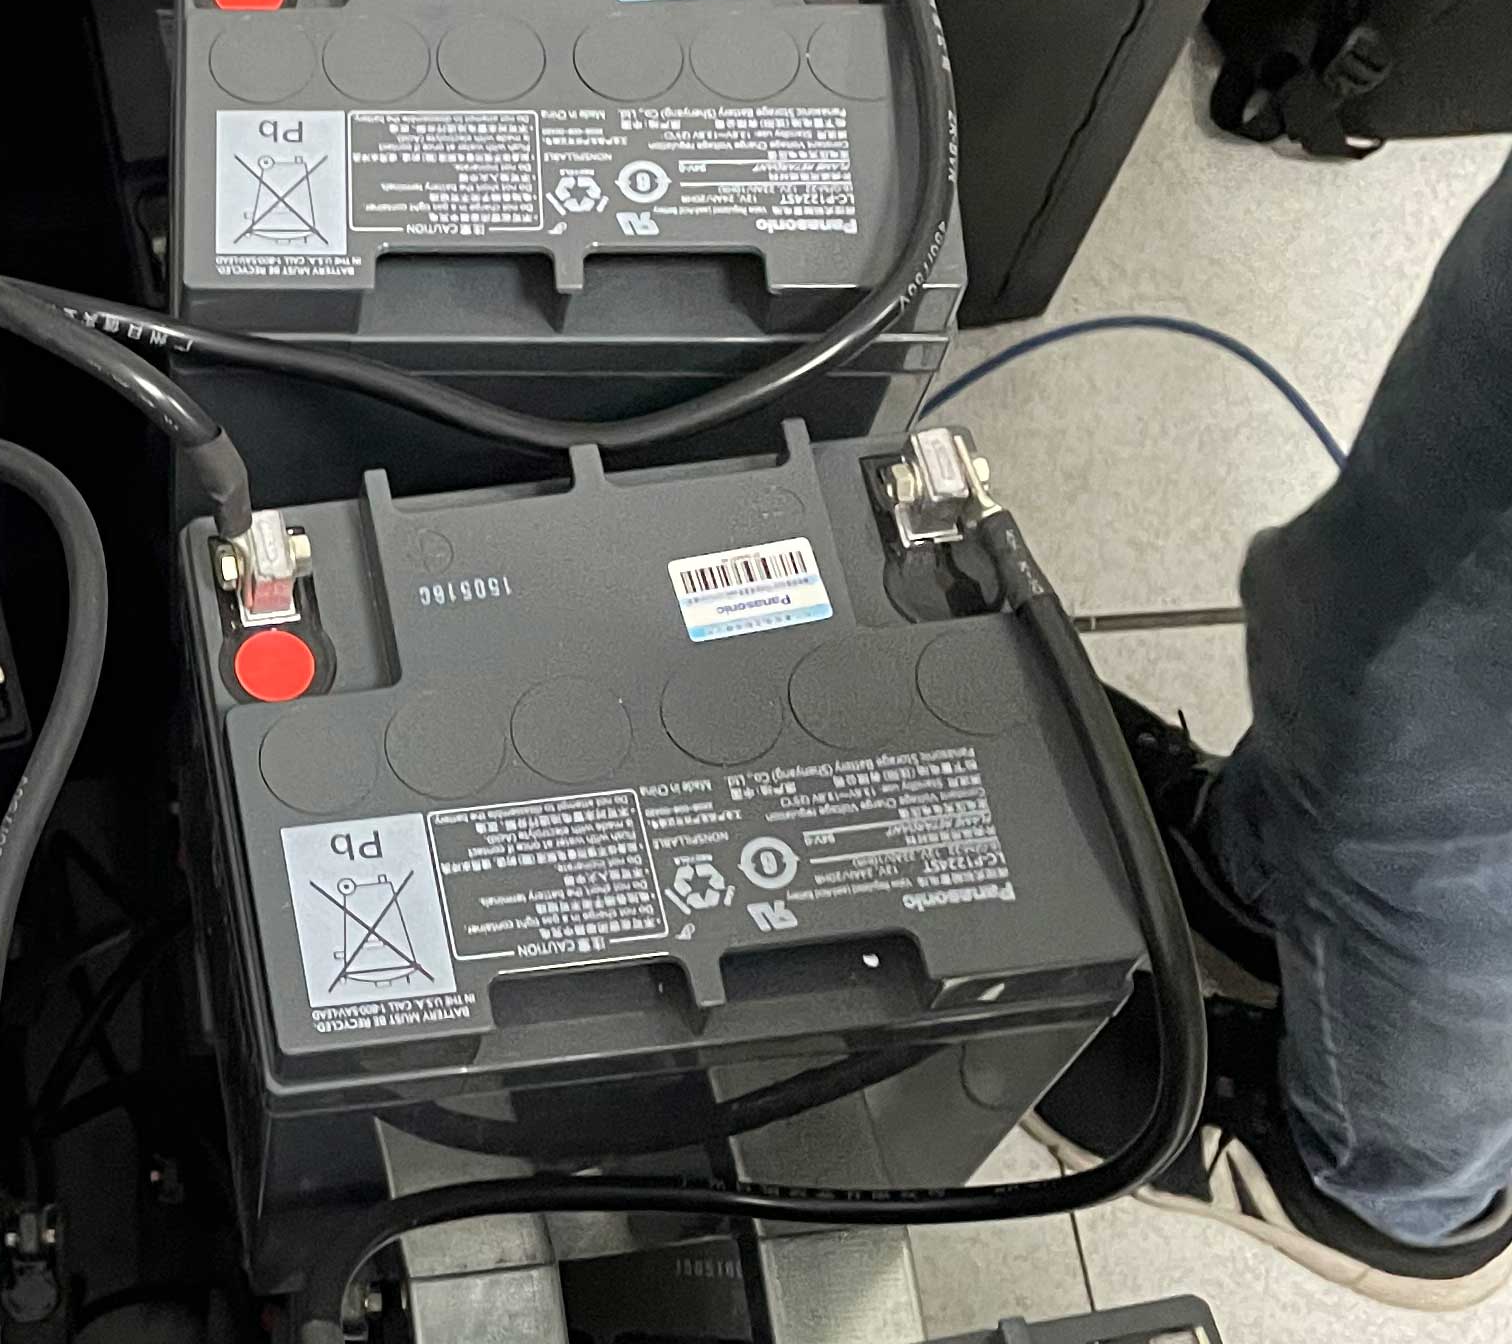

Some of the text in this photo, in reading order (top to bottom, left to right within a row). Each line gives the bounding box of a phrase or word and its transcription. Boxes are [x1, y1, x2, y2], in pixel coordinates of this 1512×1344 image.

[258, 119, 303, 143] Pb
[406, 222, 458, 234] CAUTION
[756, 216, 857, 235] Panasonic
[417, 575, 512, 605] 150516C
[715, 594, 791, 616] Panasonic
[639, 783, 669, 797] China
[327, 828, 383, 863] Pb
[900, 881, 1015, 913] Panasonic
[516, 937, 575, 957] CAUTION
[387, 998, 412, 1012] CALL
[444, 992, 463, 1005] THE
[464, 991, 475, 1003] IN
[371, 1014, 386, 1026] BE
[387, 1010, 419, 1025] MUST
[421, 1005, 469, 1021] BATTERY
